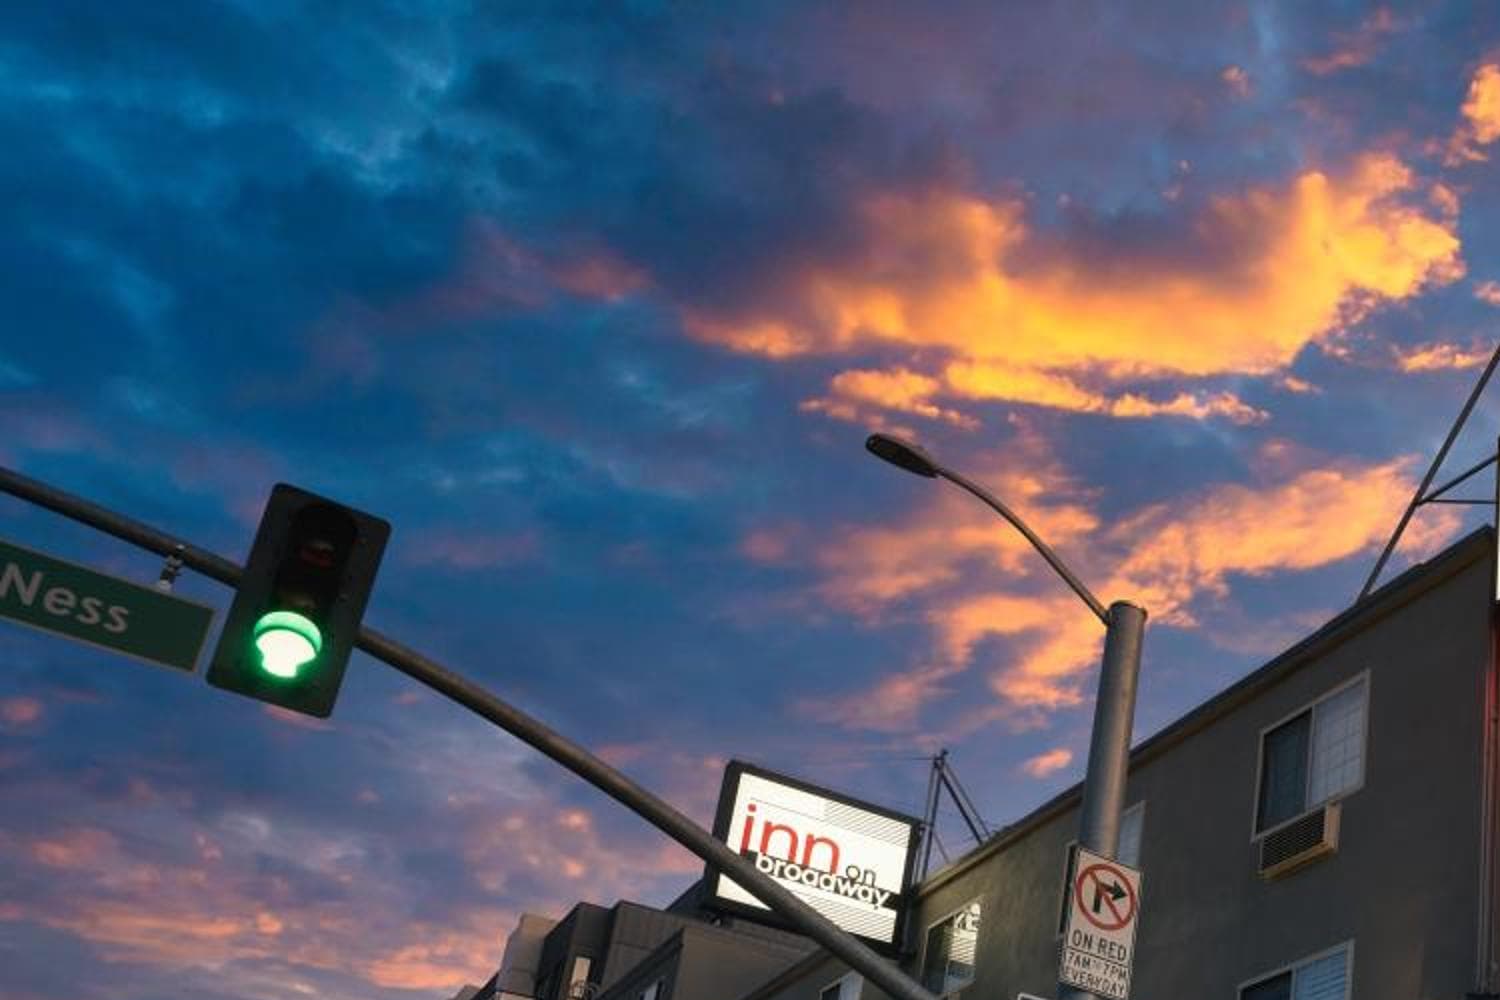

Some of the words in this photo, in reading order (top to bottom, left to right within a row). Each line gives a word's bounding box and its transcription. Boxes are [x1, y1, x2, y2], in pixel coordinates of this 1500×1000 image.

[0, 563, 130, 633] Ness
[740, 804, 840, 876] inn
[845, 864, 876, 888] on
[755, 852, 891, 910] broadway
[1071, 928, 1093, 950] ON
[1098, 936, 1127, 962] RED
[1064, 965, 1127, 995] EVERYDAY
